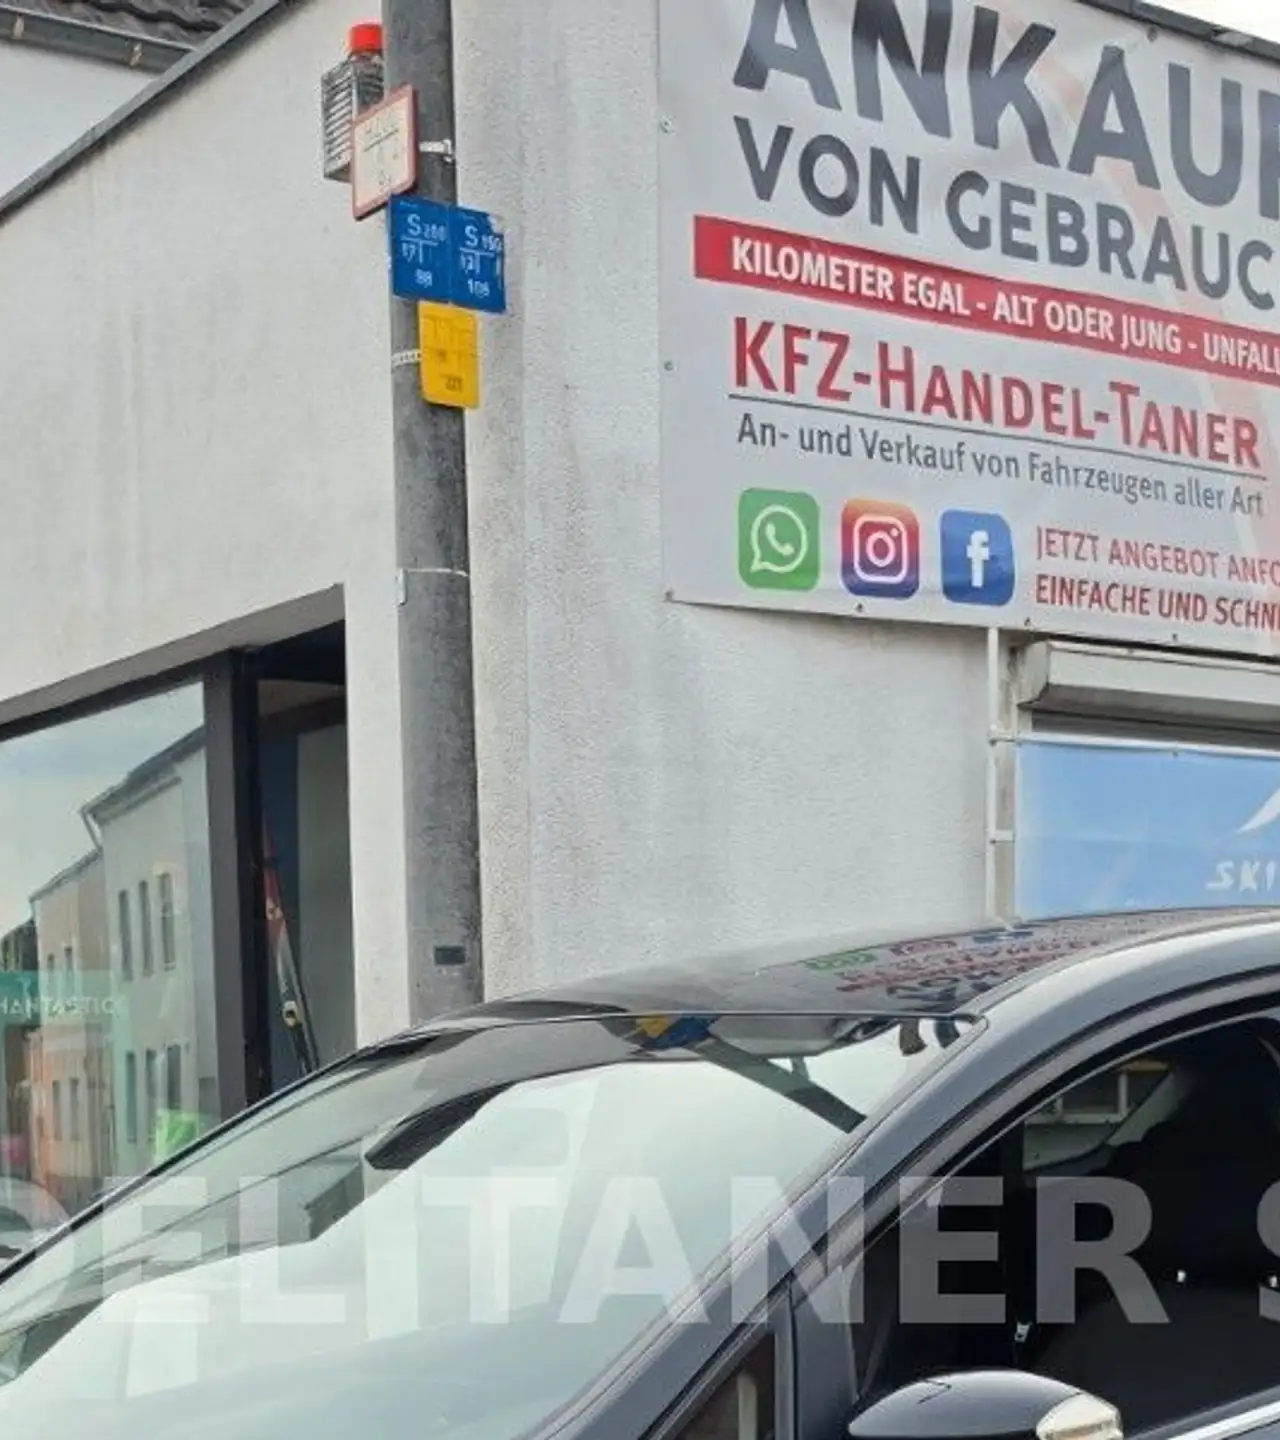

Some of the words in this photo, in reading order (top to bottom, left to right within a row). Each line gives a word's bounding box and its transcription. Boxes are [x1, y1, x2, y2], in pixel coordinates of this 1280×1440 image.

[733, 114, 922, 234] VON
[731, 235, 894, 302] KILOMETER
[902, 271, 971, 316] EGAL
[993, 291, 1038, 330] ALT
[1043, 301, 1115, 342] ODER
[1120, 314, 1183, 352] JUNG
[738, 412, 789, 447] An-
[799, 424, 852, 457] und
[858, 427, 965, 473] Verkauf
[971, 450, 1020, 479] von
[1028, 451, 1167, 505] Fahrzeugen
[1175, 477, 1225, 512] aller
[1230, 485, 1265, 518] Art
[1036, 527, 1099, 561] JETZT
[1108, 540, 1219, 580] ANGEBOT
[1035, 573, 1151, 617] EINFACHE
[1157, 587, 1208, 623] UND
[1205, 859, 1277, 893] SKI
